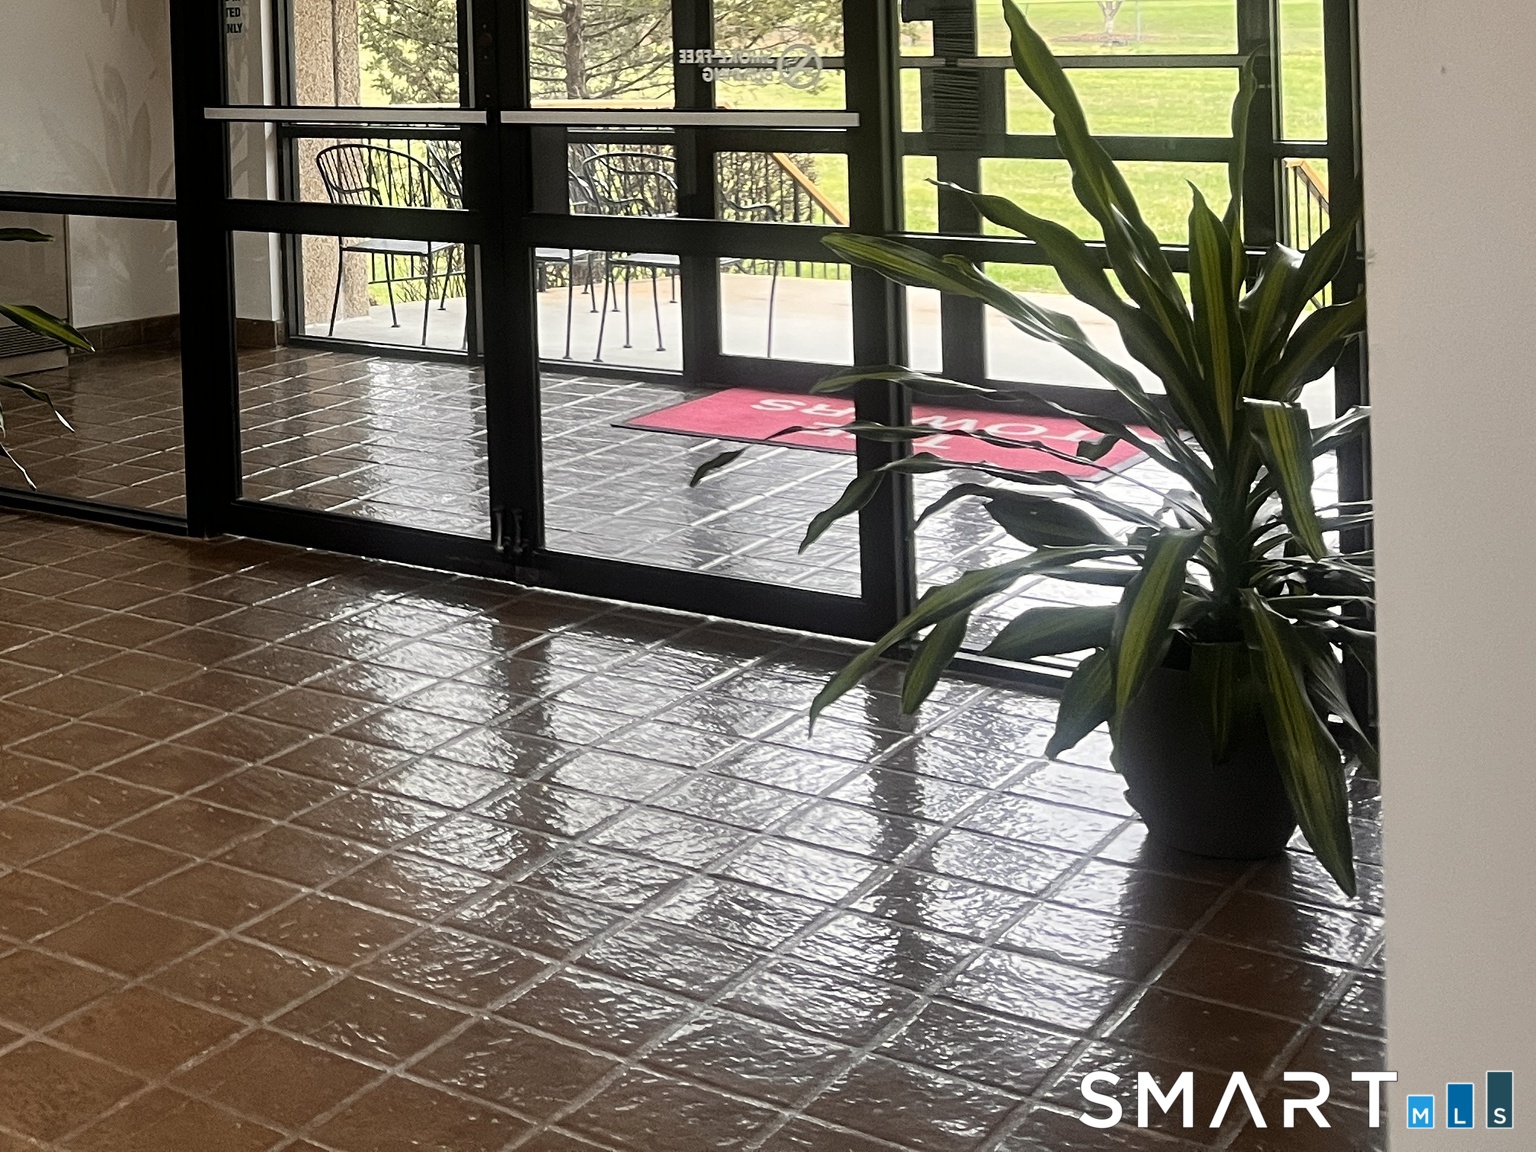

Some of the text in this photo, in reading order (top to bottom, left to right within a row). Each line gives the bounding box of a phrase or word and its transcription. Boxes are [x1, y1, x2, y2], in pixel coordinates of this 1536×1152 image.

[226, 7, 241, 17] TED
[227, 23, 243, 33] NLY
[749, 398, 1104, 446] TOWRS
